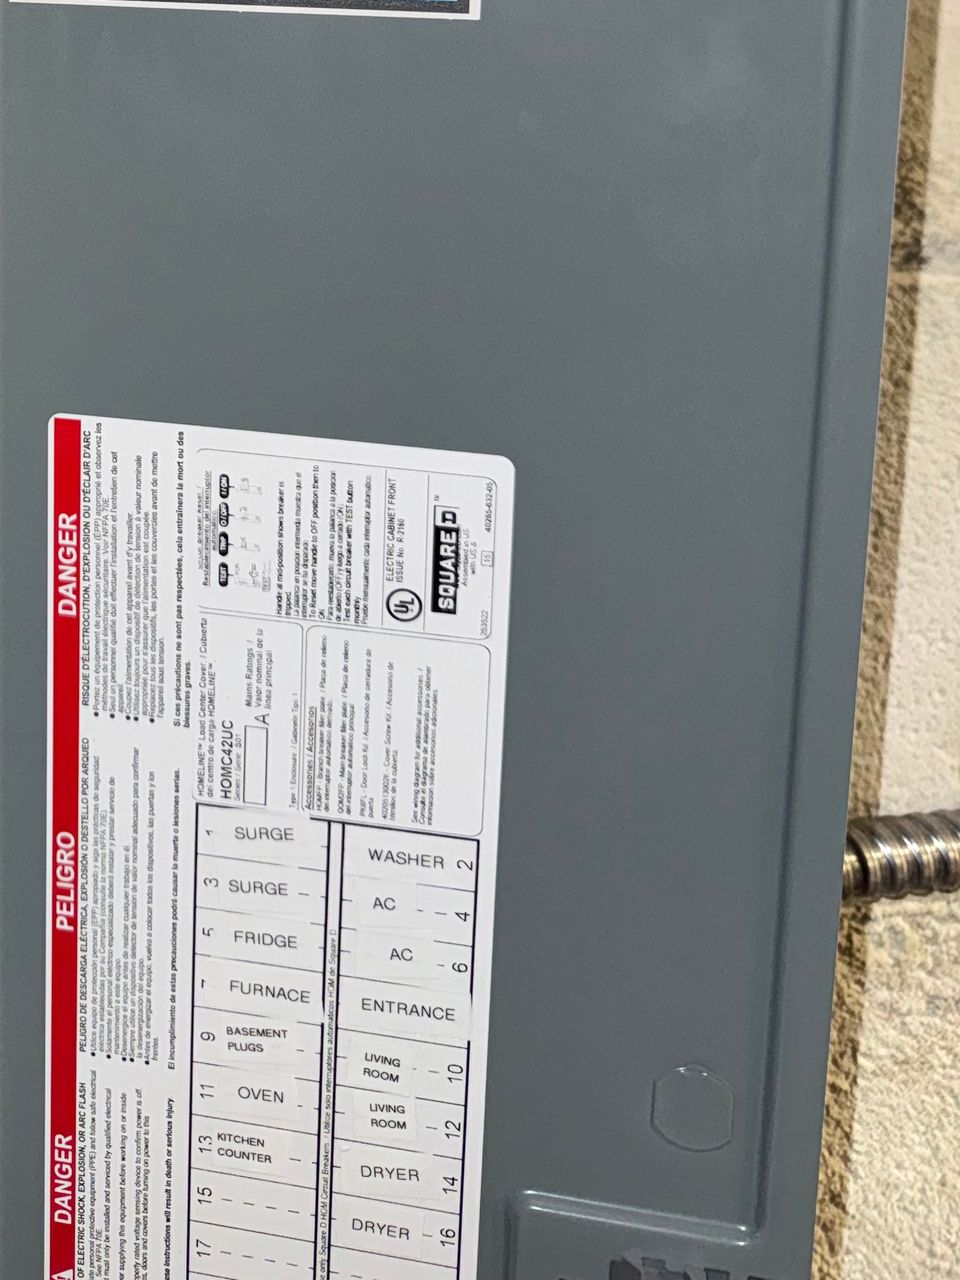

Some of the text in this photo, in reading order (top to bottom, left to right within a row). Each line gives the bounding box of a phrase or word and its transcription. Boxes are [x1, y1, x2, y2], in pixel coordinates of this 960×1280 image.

[83, 430, 92, 459] D'ARC
[82, 461, 91, 503] D'ÉCLAIR
[83, 505, 91, 519] OU
[386, 478, 396, 581] ELECTRIC CABINET FRONT
[82, 521, 91, 582] D'EXPLOSION
[57, 513, 77, 617] DANGER
[396, 560, 404, 582] ISSUE
[438, 530, 457, 609] SQUARE
[81, 673, 90, 706] RISQUE
[81, 737, 90, 775] ARQUEO
[221, 720, 233, 799] HOMC42UC
[81, 777, 90, 795] POR
[81, 797, 90, 842] DESTELLO
[235, 827, 294, 841] SURGE
[368, 848, 444, 869] WASHER
[457, 858, 473, 871] 2
[56, 831, 75, 931] PELIGRO
[80, 853, 89, 901] EXPLOSIÓN
[203, 878, 219, 887] 3
[229, 881, 288, 896] SURGE
[373, 897, 396, 911] AC
[455, 912, 470, 922] 4
[234, 931, 297, 949] FRIDGE
[390, 948, 413, 961] AC
[452, 962, 468, 973] 6
[79, 954, 88, 1001] DESCARGA
[230, 981, 310, 1004] FURNACE
[79, 1003, 87, 1014] DE
[361, 998, 455, 1021] ENTRANCE
[78, 1017, 87, 1052] PELIGRO
[201, 1032, 215, 1040] 9
[226, 1026, 288, 1039] BASEMENT
[227, 1042, 263, 1053] PLUGS
[365, 1053, 400, 1068] LIVING
[363, 1068, 399, 1083] ROOM
[447, 1064, 464, 1082] 10
[200, 1084, 215, 1100] 11
[238, 1087, 284, 1104] OVEN
[369, 1104, 405, 1115] LIVING
[371, 1119, 406, 1131] ROOM
[445, 1120, 461, 1139] 12
[198, 1136, 212, 1154] 13
[217, 1133, 265, 1147] KITCHEN
[217, 1147, 272, 1163] COUNTER
[54, 1134, 73, 1224] DANGER
[77, 1082, 87, 1278] OF ELECTRIC SHOCK, EXPLOSION, OR ARC FLASH
[361, 1165, 420, 1182] DRYER
[443, 1176, 459, 1195] 14
[197, 1186, 212, 1204] 15
[352, 1218, 410, 1240] DRYER
[440, 1228, 456, 1246] 16
[196, 1240, 211, 1258] 17
